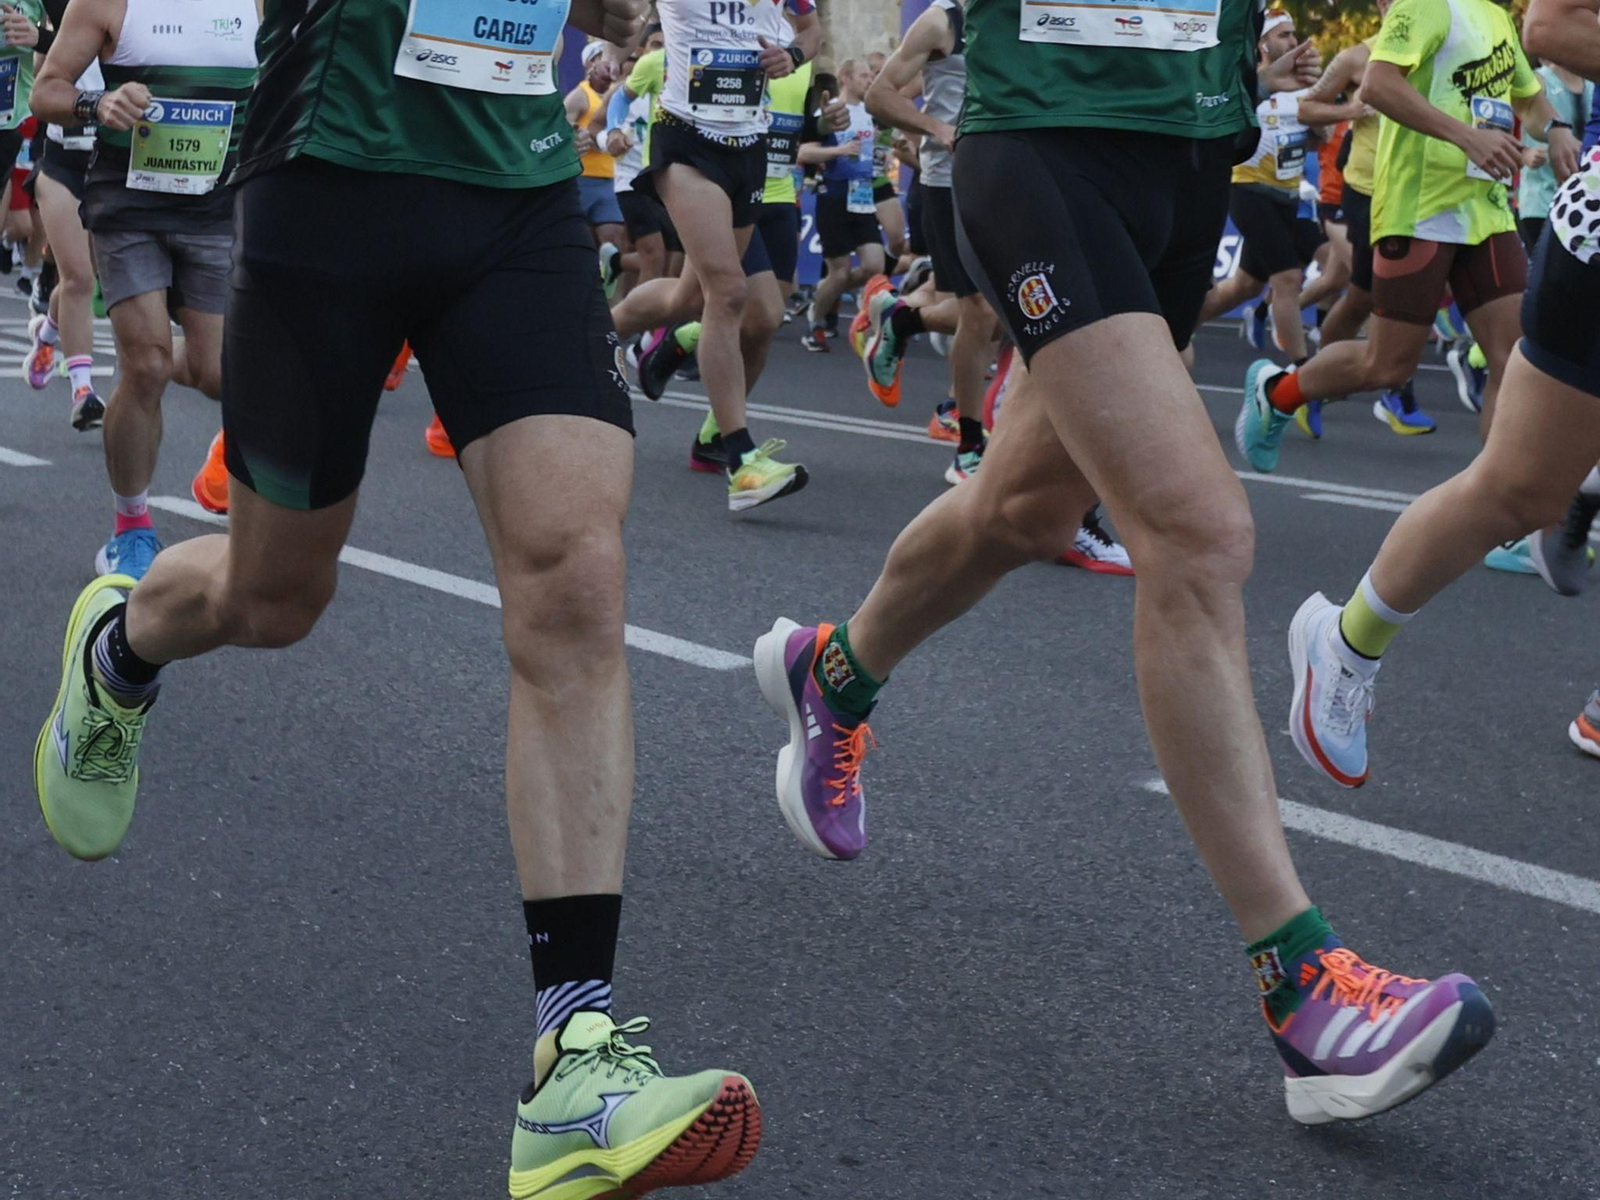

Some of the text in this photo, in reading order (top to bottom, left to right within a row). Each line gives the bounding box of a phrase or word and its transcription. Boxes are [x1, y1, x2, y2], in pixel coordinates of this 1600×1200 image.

[1049, 16, 1075, 27] asics
[152, 25, 183, 34] GOBIK
[473, 16, 538, 45] CARLES
[430, 52, 458, 66] asics
[718, 53, 759, 64] ZURICH
[716, 77, 743, 89] 3258
[712, 93, 746, 104] PIQUITO
[171, 108, 224, 122] ZURICH
[169, 138, 201, 153] 1579
[771, 137, 790, 149] 2471
[143, 156, 219, 171] JUANITASTYLE
